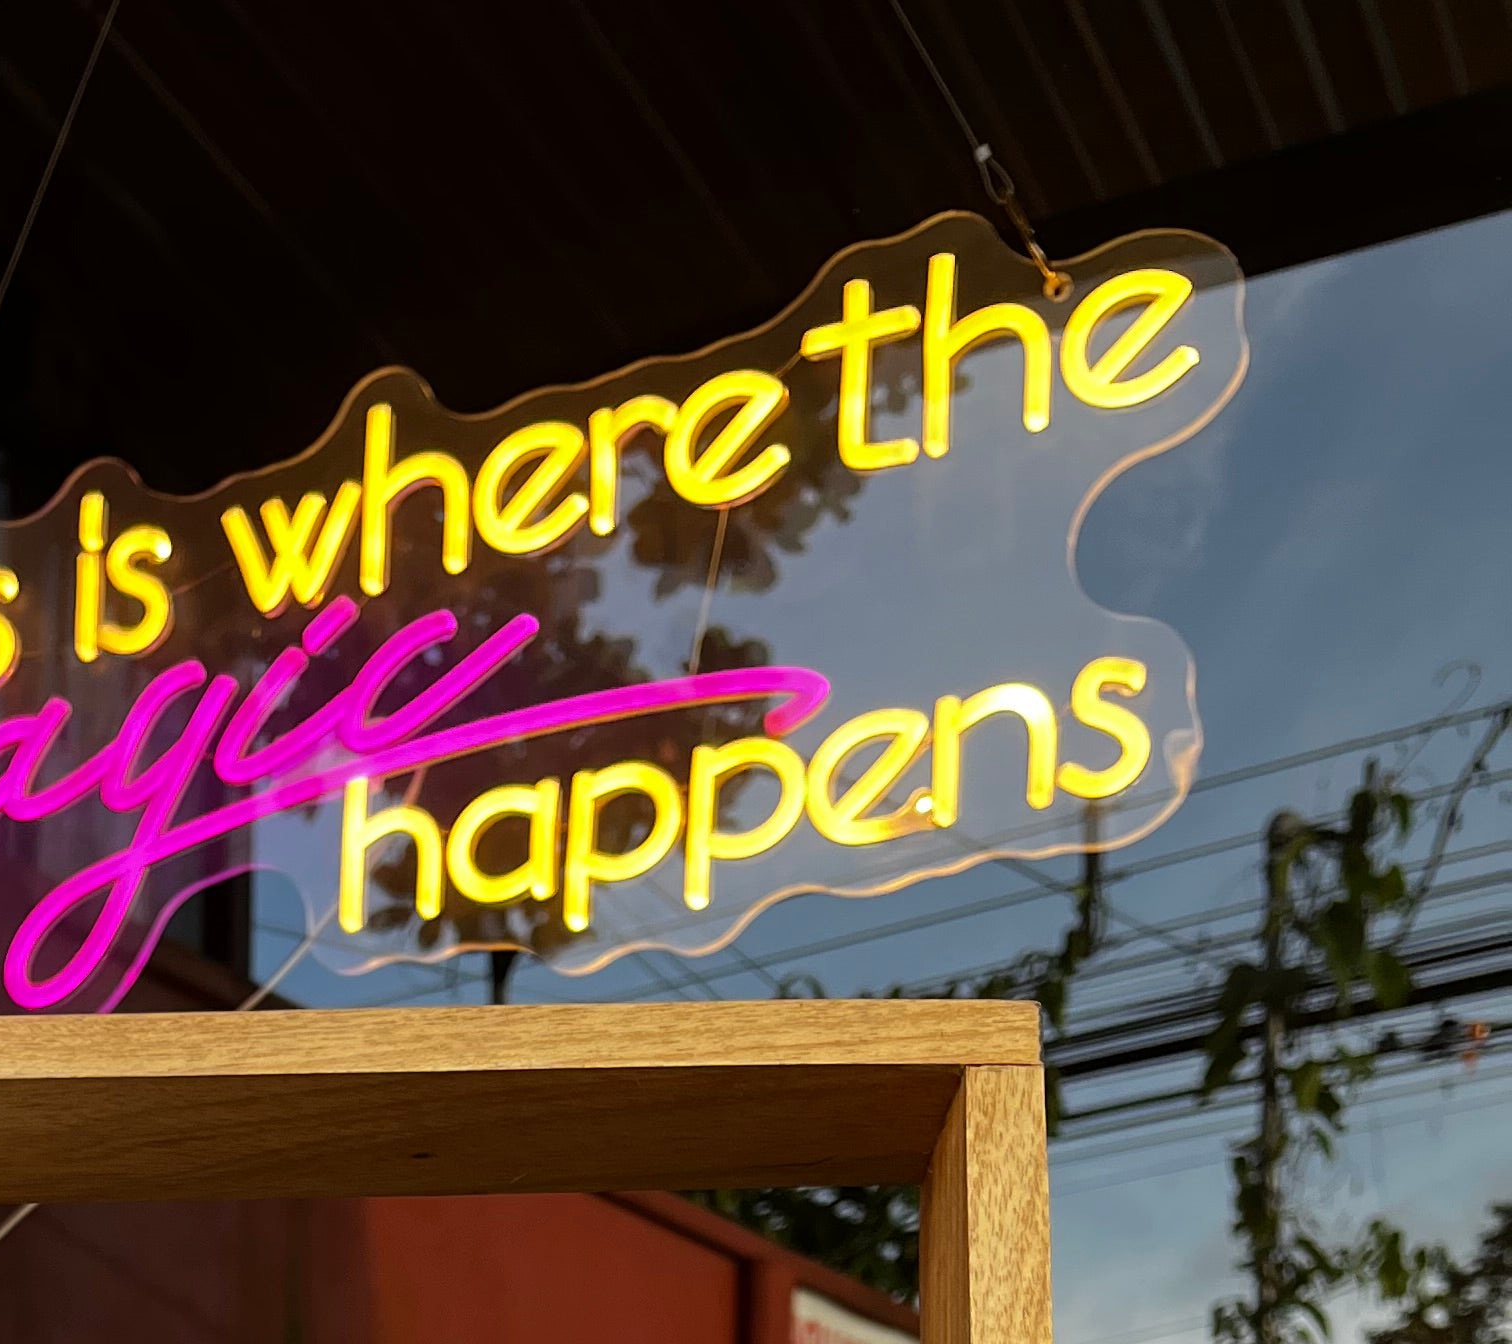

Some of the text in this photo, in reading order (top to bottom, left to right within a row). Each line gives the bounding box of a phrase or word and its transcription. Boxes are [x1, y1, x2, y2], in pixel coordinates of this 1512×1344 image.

[73, 490, 173, 663] is
[220, 371, 792, 614] where
[800, 250, 1201, 471] the
[339, 656, 1152, 934] happens
